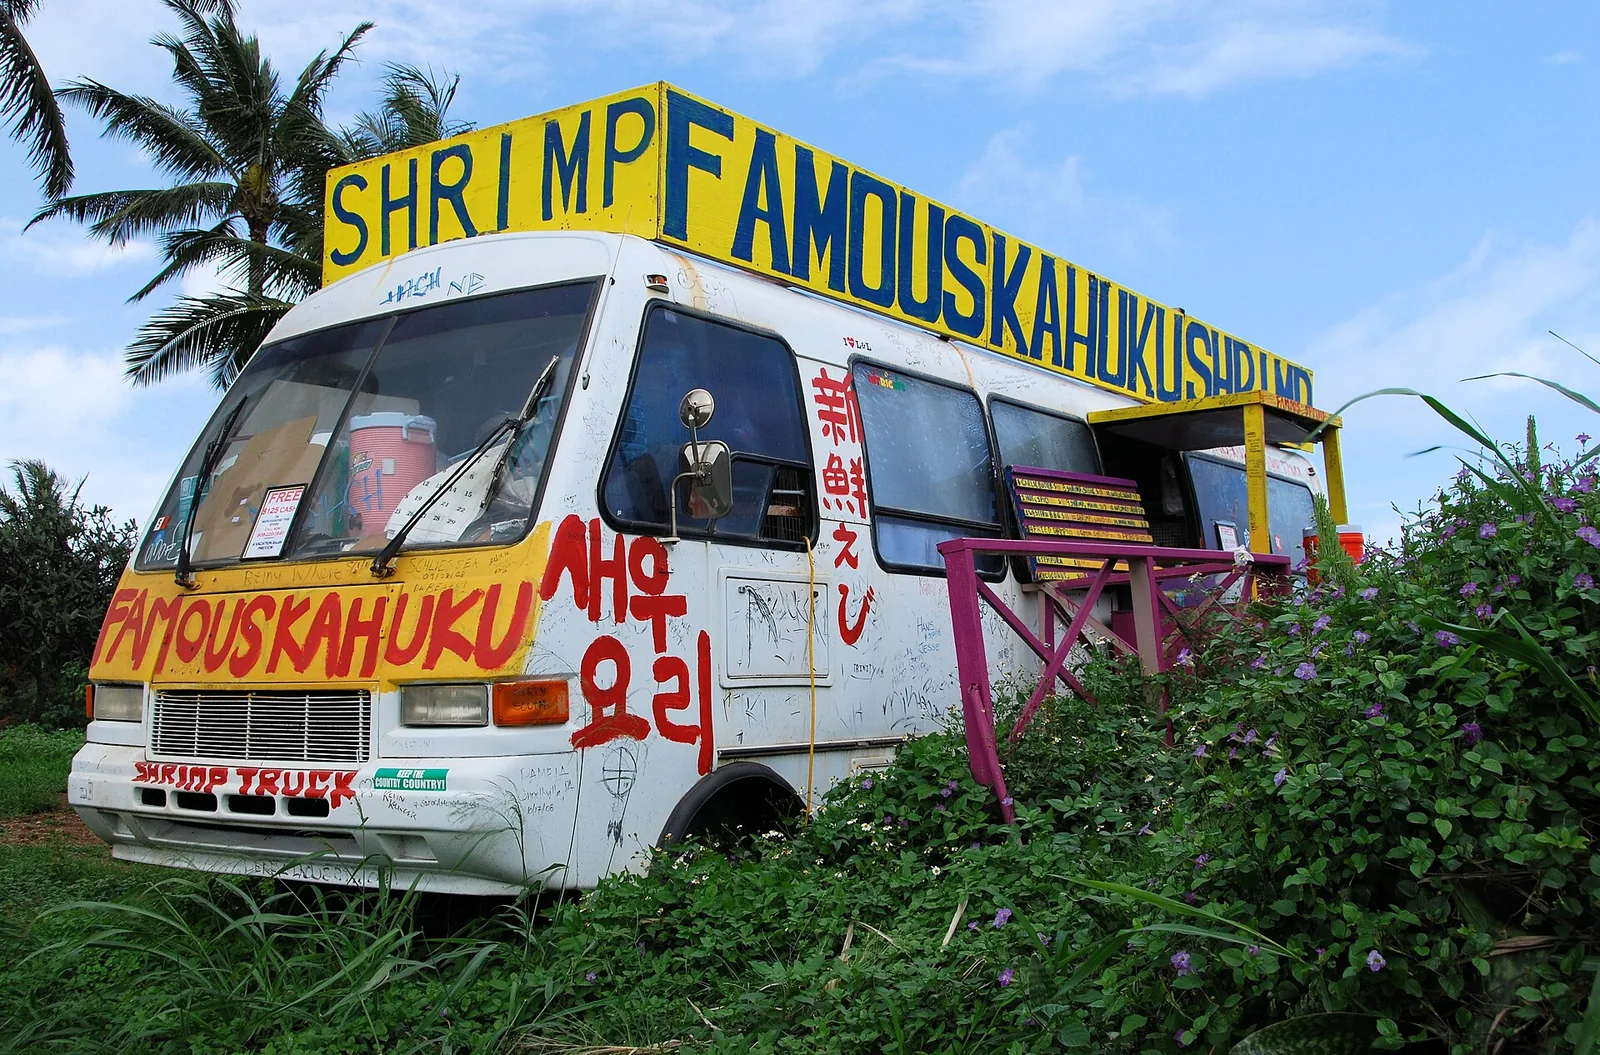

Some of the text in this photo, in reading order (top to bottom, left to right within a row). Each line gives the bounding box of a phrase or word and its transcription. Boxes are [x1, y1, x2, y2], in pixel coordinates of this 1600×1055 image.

[330, 96, 656, 267] SHRIMP
[269, 490, 304, 504] FREE
[464, 490, 473, 498] 15
[396, 769, 426, 779] KEEP THE
[131, 761, 359, 810] SHRIMP TRUCK
[402, 778, 446, 791] COUNTRY!
